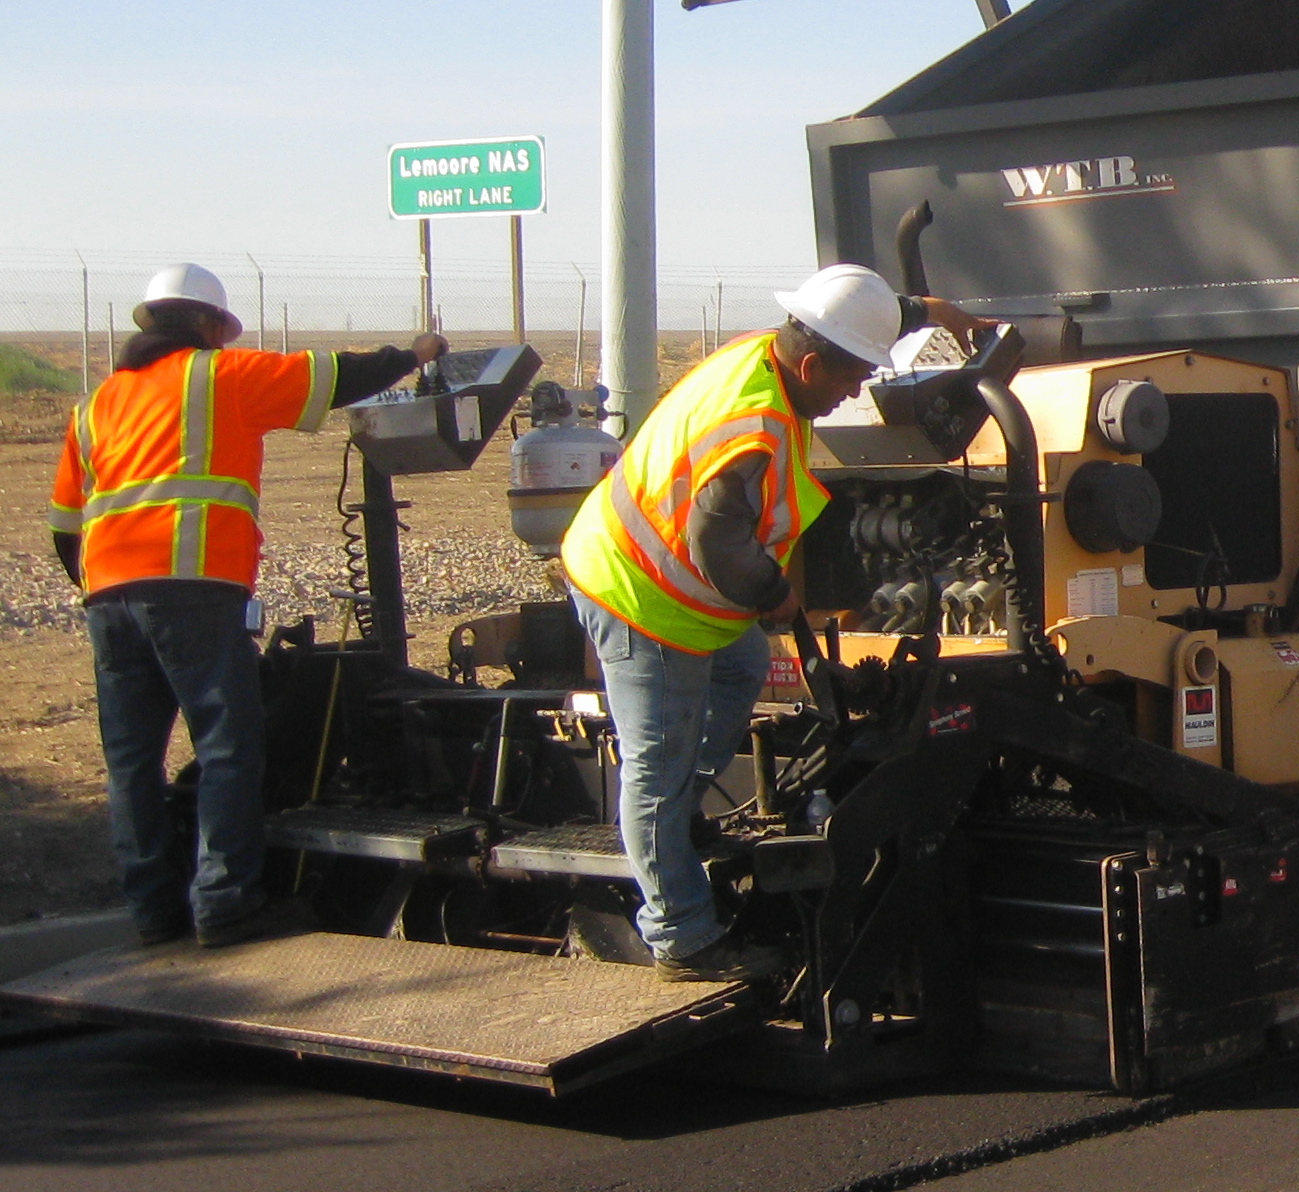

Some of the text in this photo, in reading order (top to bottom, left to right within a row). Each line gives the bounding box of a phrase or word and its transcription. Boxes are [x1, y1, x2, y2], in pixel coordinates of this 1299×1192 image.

[400, 148, 530, 178] Lemoore NAS
[418, 186, 513, 208] RIGHT LANE
